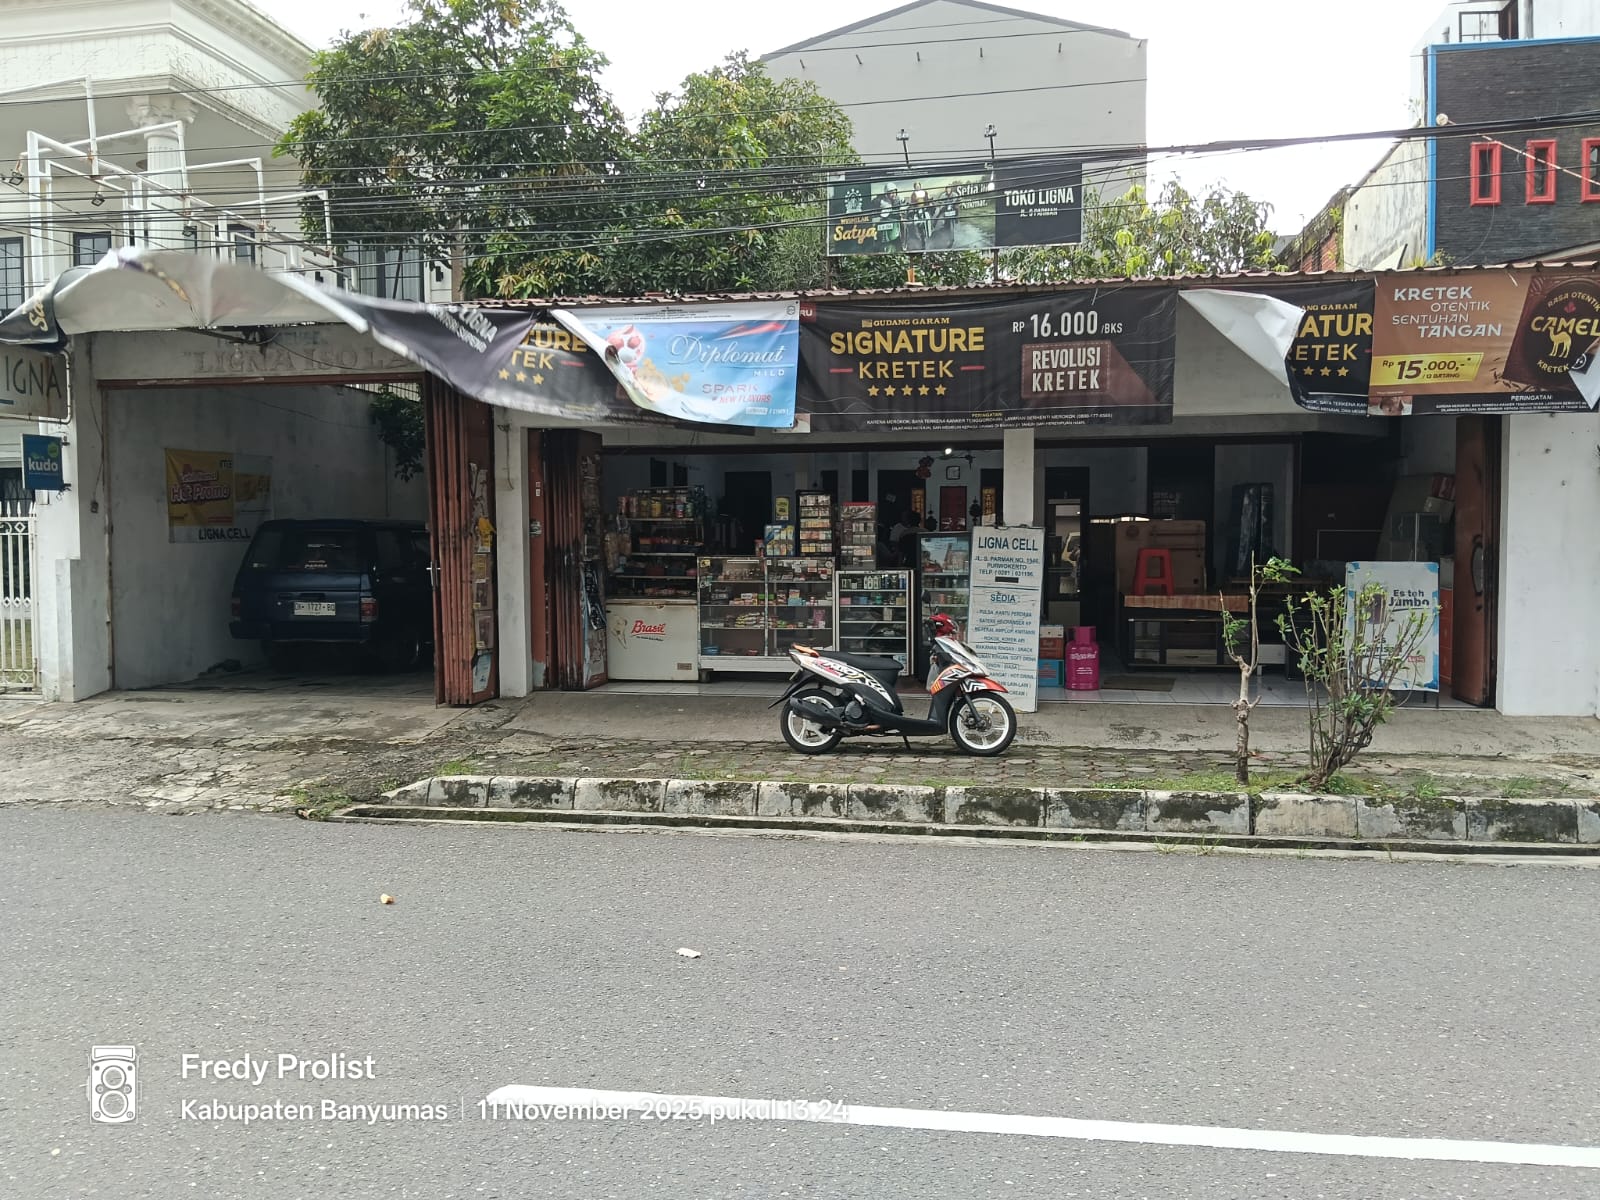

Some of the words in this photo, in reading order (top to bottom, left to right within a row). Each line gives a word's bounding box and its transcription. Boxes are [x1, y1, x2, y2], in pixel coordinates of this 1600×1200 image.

[1004, 190, 1036, 206] TOKO
[1038, 187, 1075, 205] LIGNA
[833, 224, 877, 245] Satya
[1394, 286, 1473, 301] KRETEK
[1548, 293, 1569, 307] RASA
[1320, 303, 1358, 311] GARAM
[1430, 301, 1490, 312] OTENTIK
[873, 319, 910, 327] GUDANG
[912, 317, 950, 325] GARAM
[1012, 321, 1025, 333] RP
[1030, 310, 1099, 338] 16.000
[1296, 313, 1373, 338] ATUR
[1392, 313, 1469, 325] SENTUHAN
[1530, 316, 1600, 337] CAMEL
[1418, 323, 1502, 338] TANGAN
[830, 327, 985, 355] SIGNATURE
[668, 334, 785, 372] Diplomat
[1032, 346, 1101, 370] REVOLUSI
[1287, 343, 1358, 361] ETEK
[859, 360, 955, 379] KRETEK
[1382, 360, 1394, 368] Rp
[1537, 359, 1569, 373] KRETEK
[753, 369, 785, 377] MILD
[1032, 369, 1100, 392] KRETEK
[702, 383, 758, 394] SPARK
[28, 458, 59, 472] kudo
[198, 528, 226, 540] LIGNA
[226, 528, 251, 539] CELL
[978, 536, 1009, 549] LIGNA
[1012, 537, 1039, 551] CELL
[990, 594, 1016, 602] SEDIA
[1393, 589, 1405, 597] Es
[631, 619, 667, 634] Brasil
